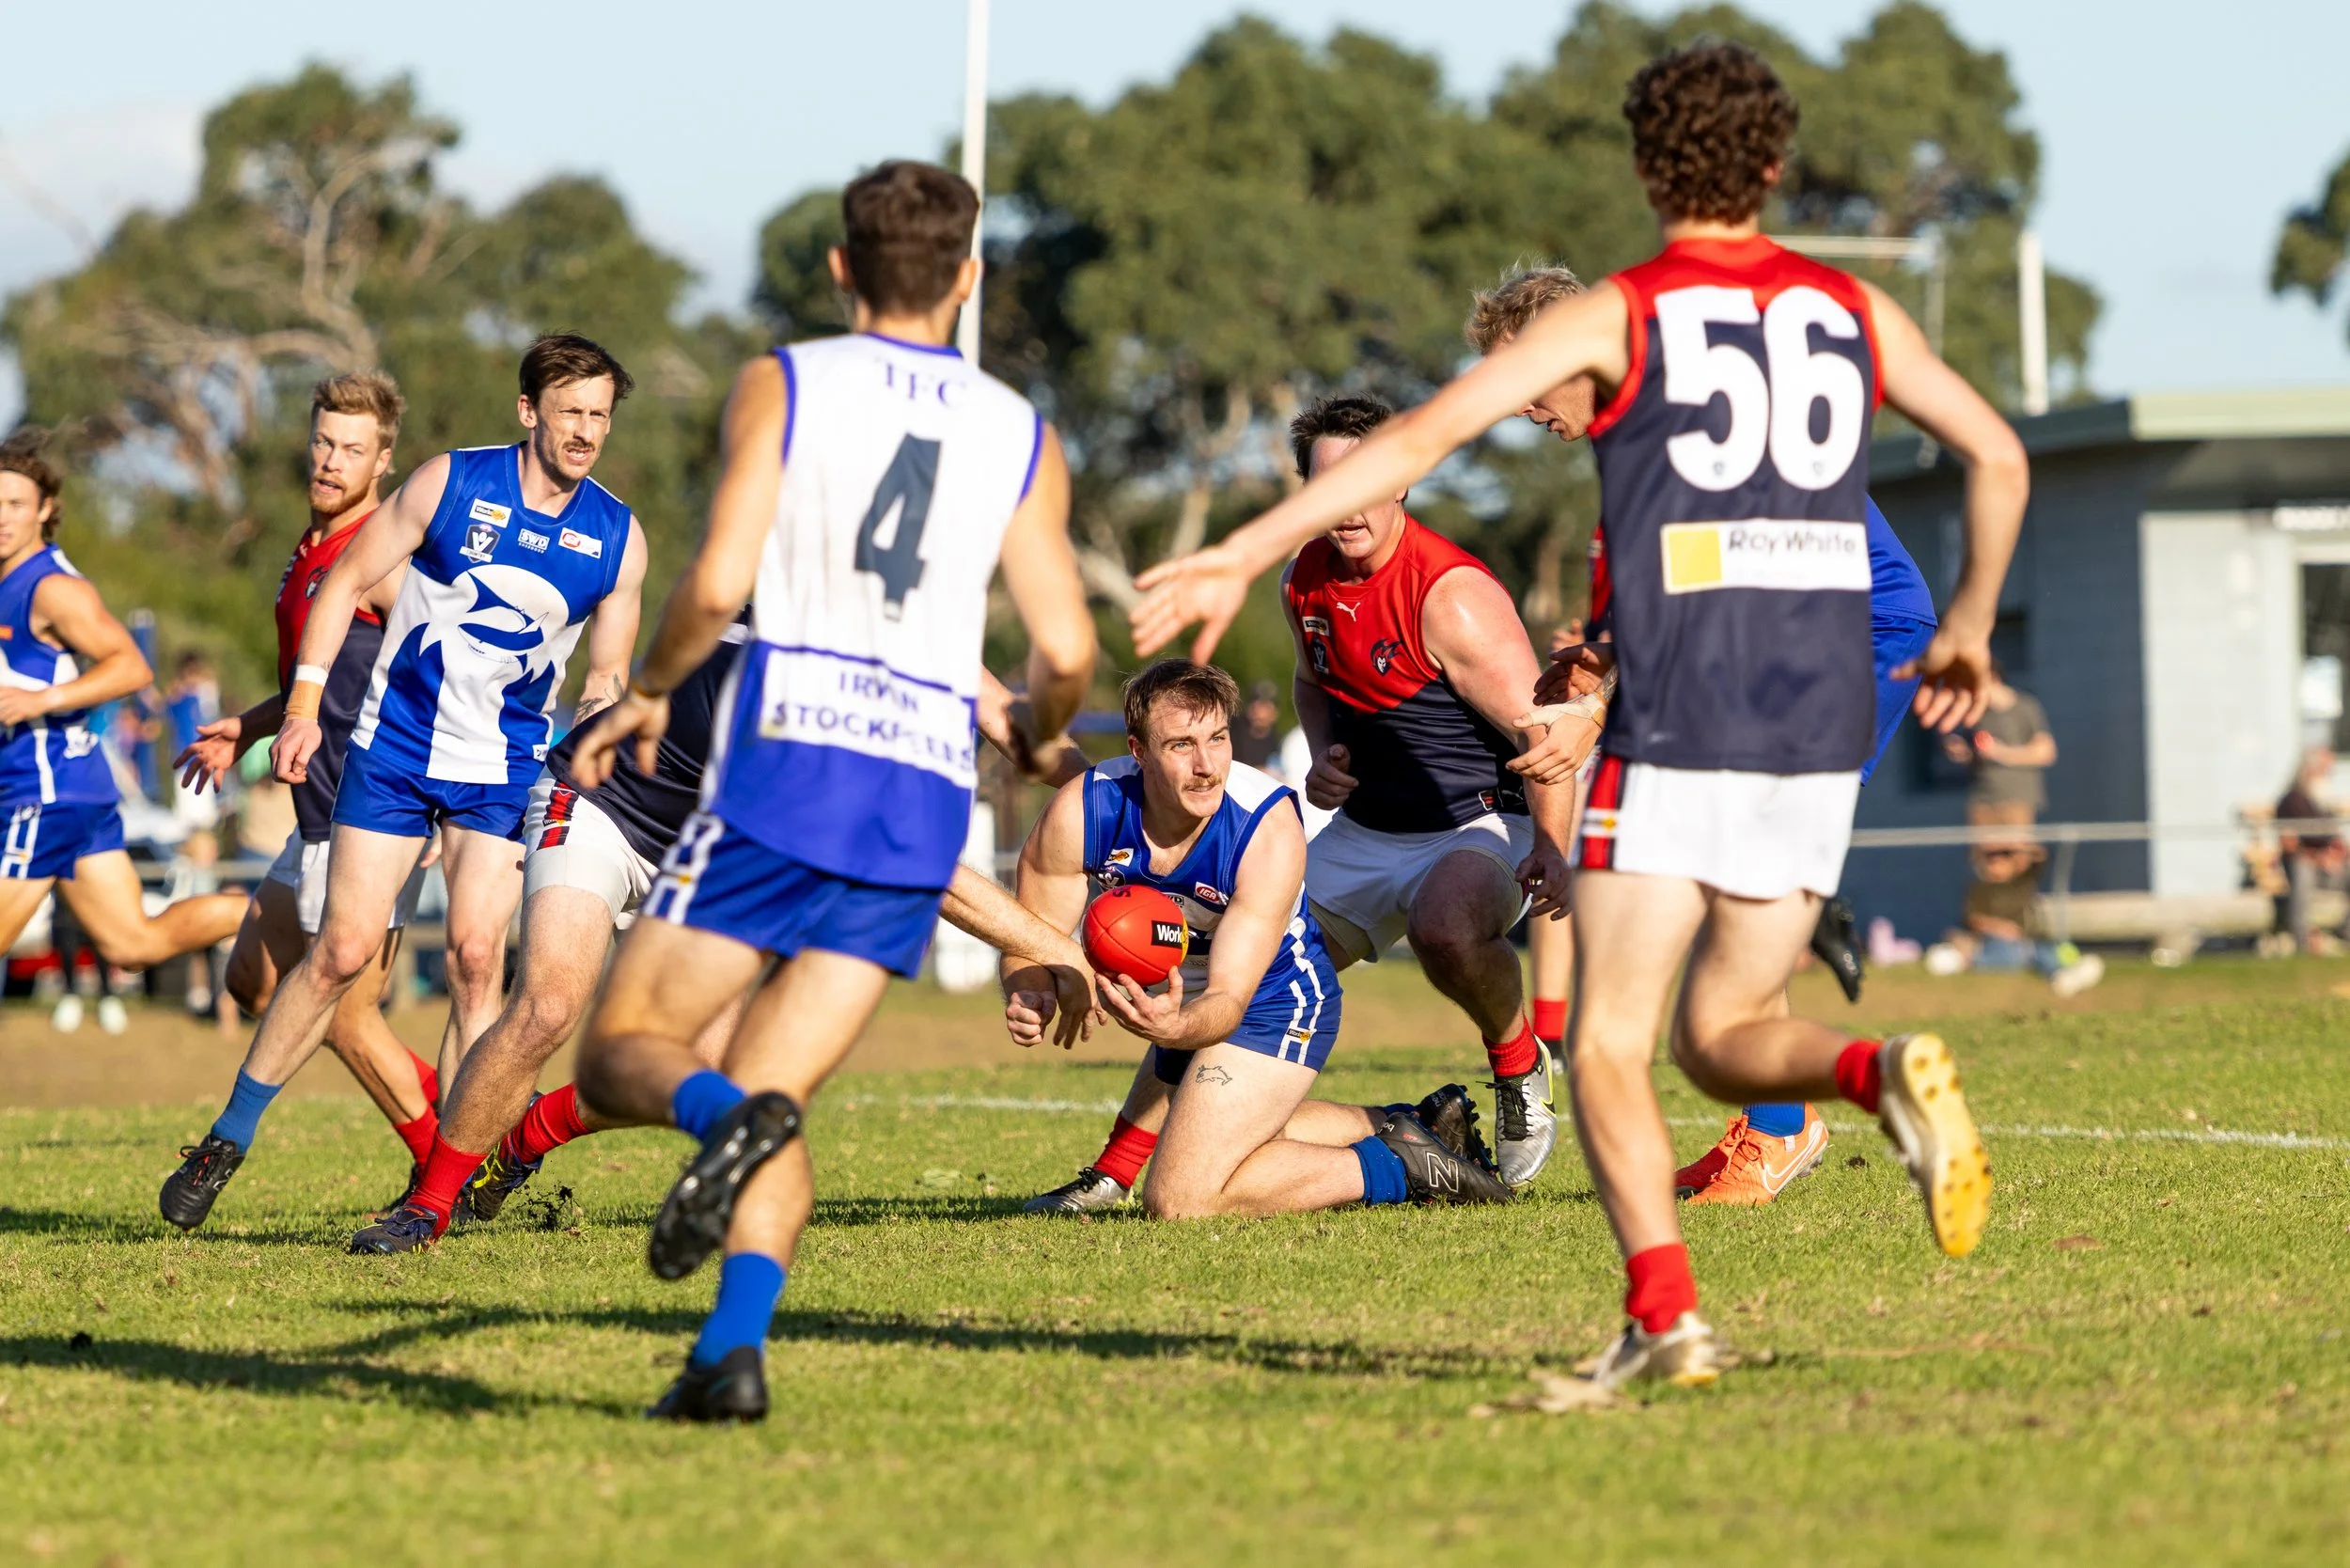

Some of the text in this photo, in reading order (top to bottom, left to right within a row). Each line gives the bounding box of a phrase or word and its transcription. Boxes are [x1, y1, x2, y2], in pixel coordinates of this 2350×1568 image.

[875, 357, 968, 408] TFC
[1654, 286, 1865, 492] 56
[853, 431, 942, 622] 4
[522, 531, 547, 548] SWD
[1785, 529, 1856, 553] White
[1199, 888, 1217, 900] IGA
[1157, 924, 1183, 943] Work
